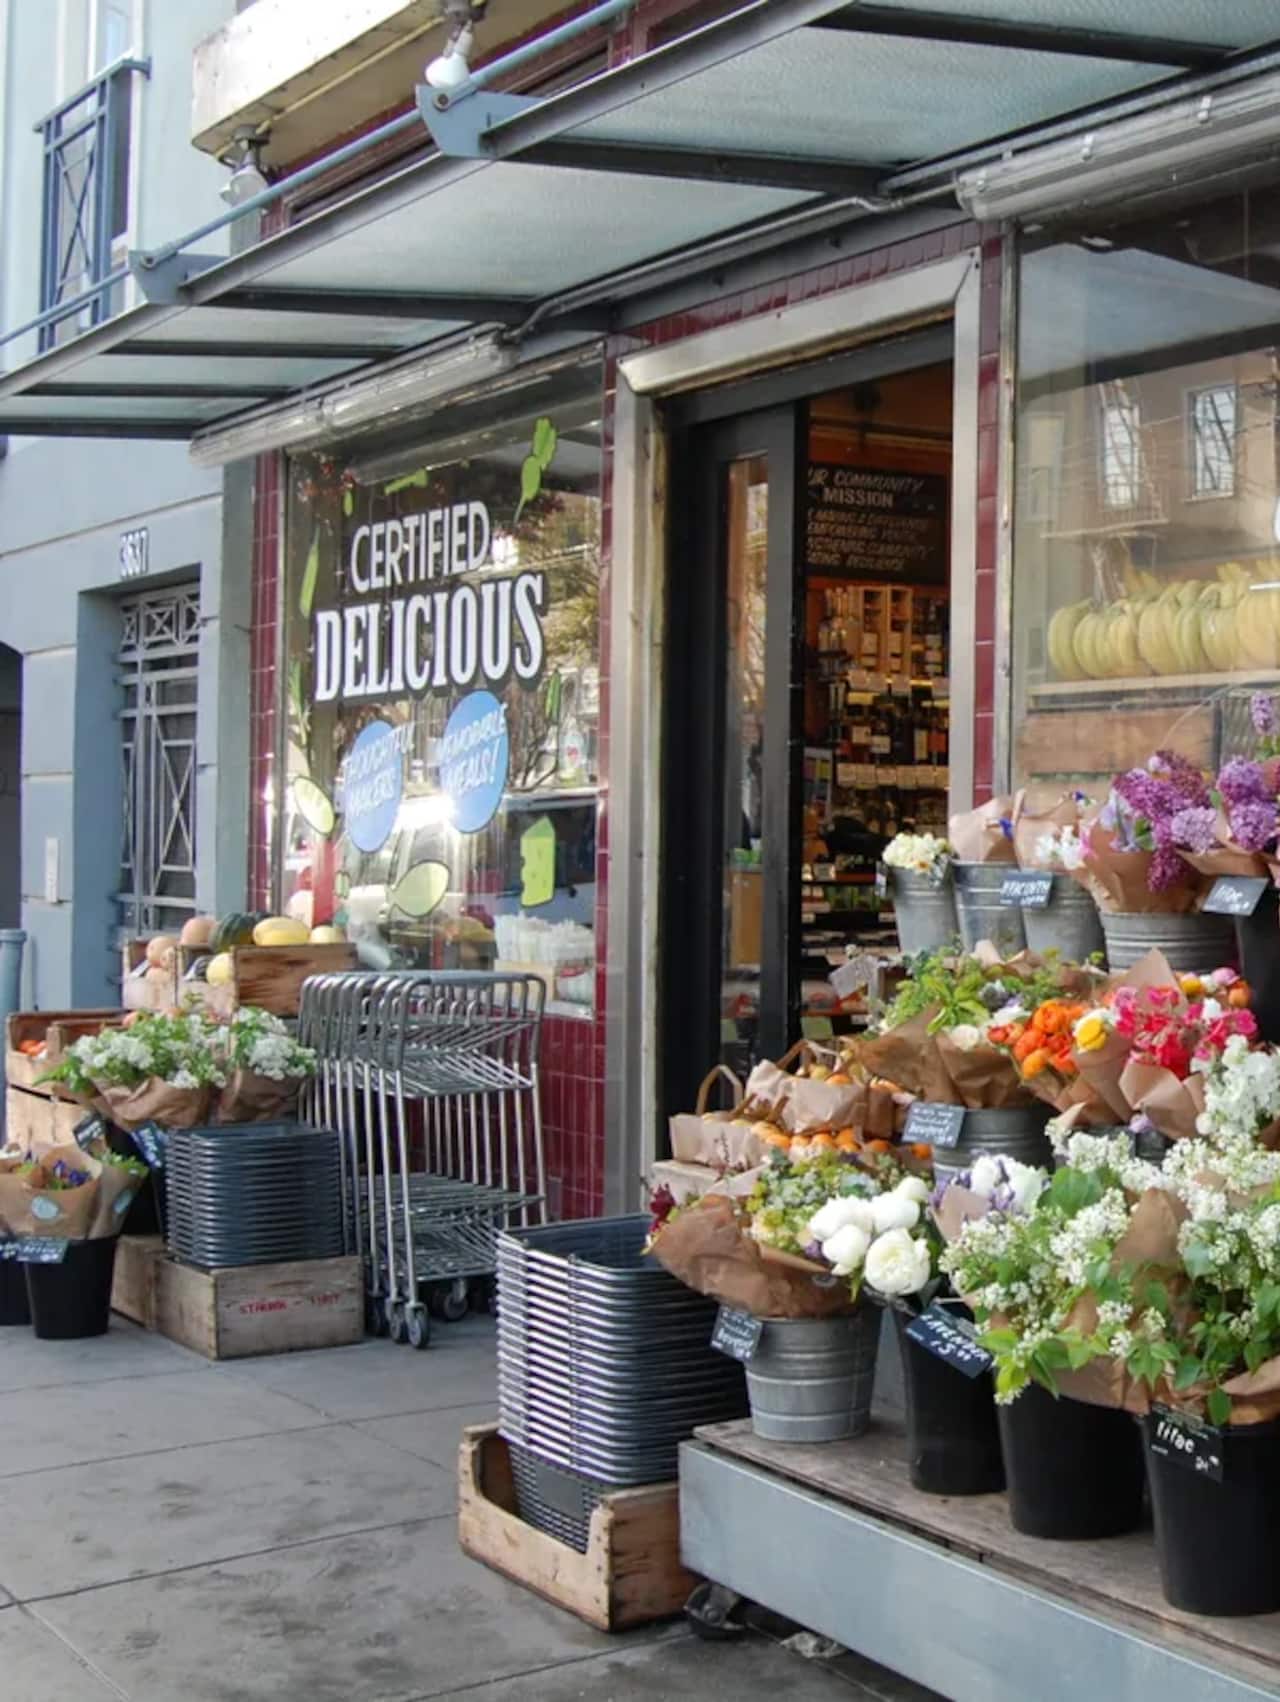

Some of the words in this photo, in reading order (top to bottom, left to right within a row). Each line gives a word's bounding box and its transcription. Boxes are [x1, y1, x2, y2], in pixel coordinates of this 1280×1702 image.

[821, 486, 895, 508] MISSION
[350, 500, 490, 594] CERTIFIED
[314, 573, 544, 701] DELICIOUS
